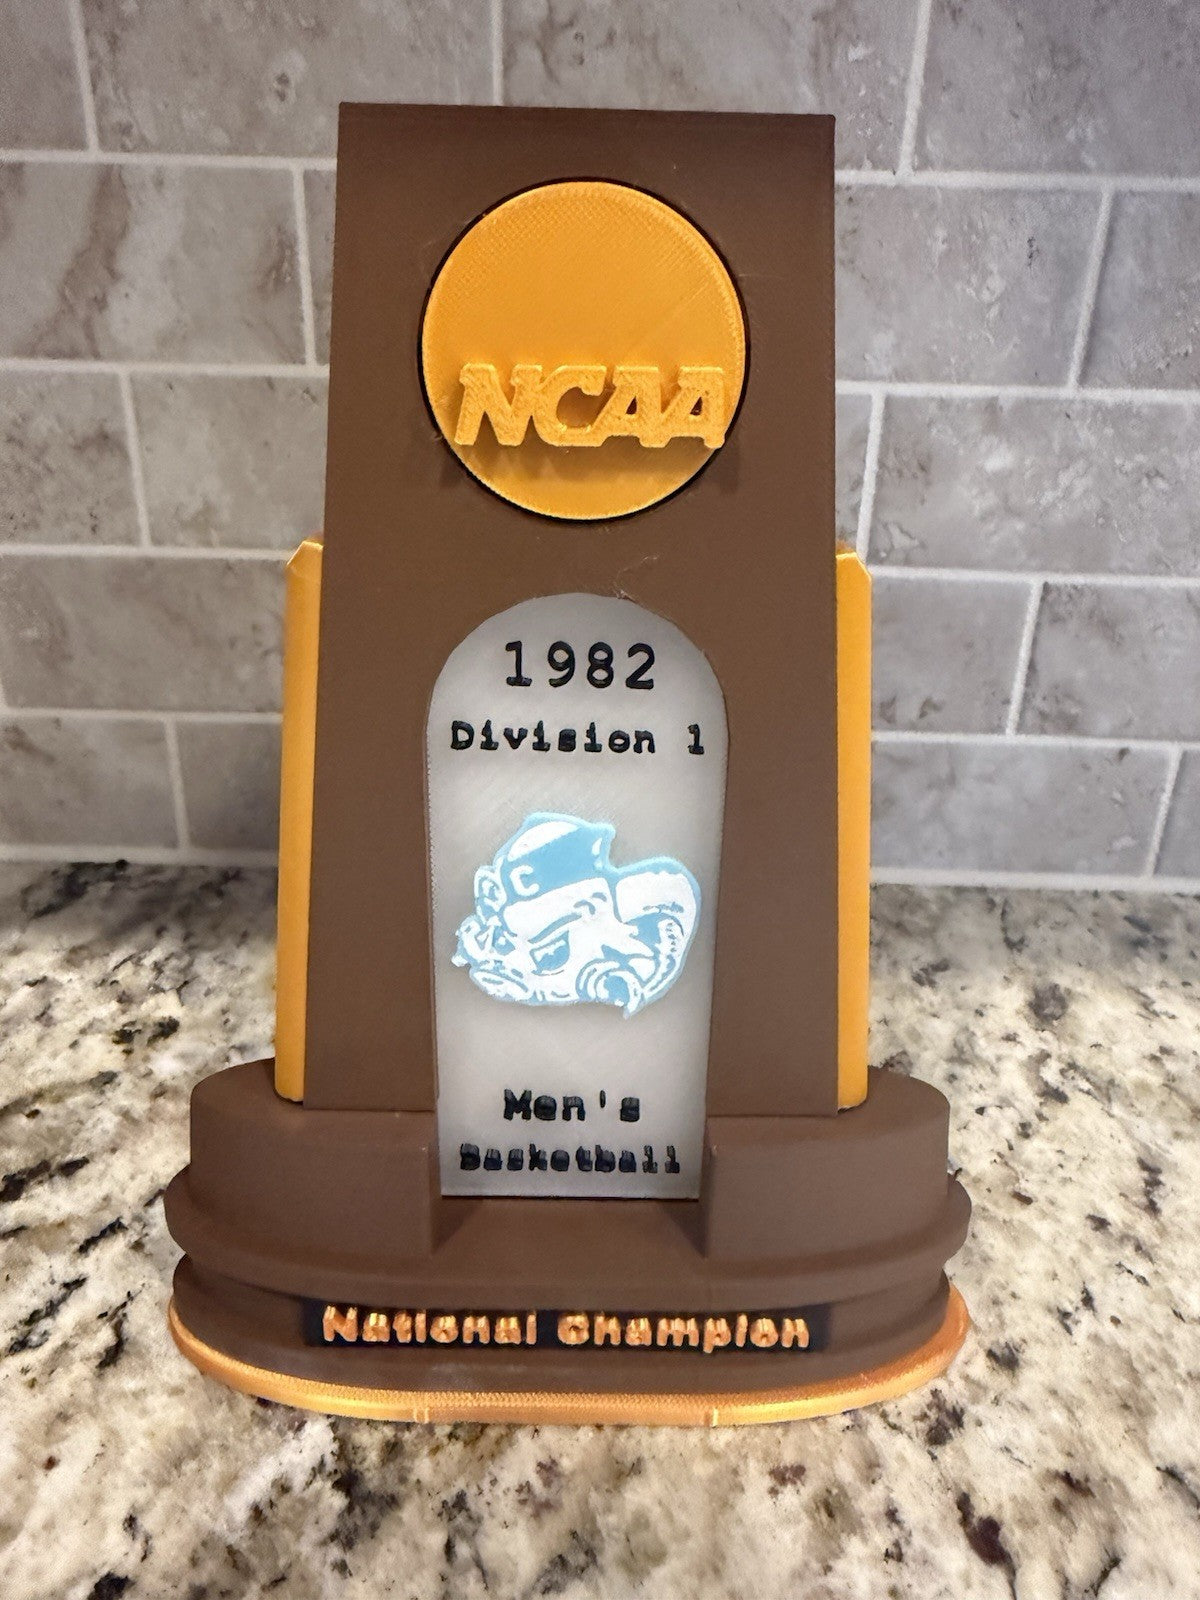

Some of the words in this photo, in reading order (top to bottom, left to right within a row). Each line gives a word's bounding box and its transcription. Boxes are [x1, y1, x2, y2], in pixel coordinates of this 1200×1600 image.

[454, 363, 726, 449] NCAA
[505, 640, 655, 690] 1982
[450, 719, 656, 753] Division
[687, 723, 704, 755] 1
[509, 864, 540, 896] C
[503, 1088, 641, 1123] Men's
[459, 1142, 681, 1174] Basketball
[322, 1305, 537, 1346] National
[557, 1310, 810, 1354] Champion
